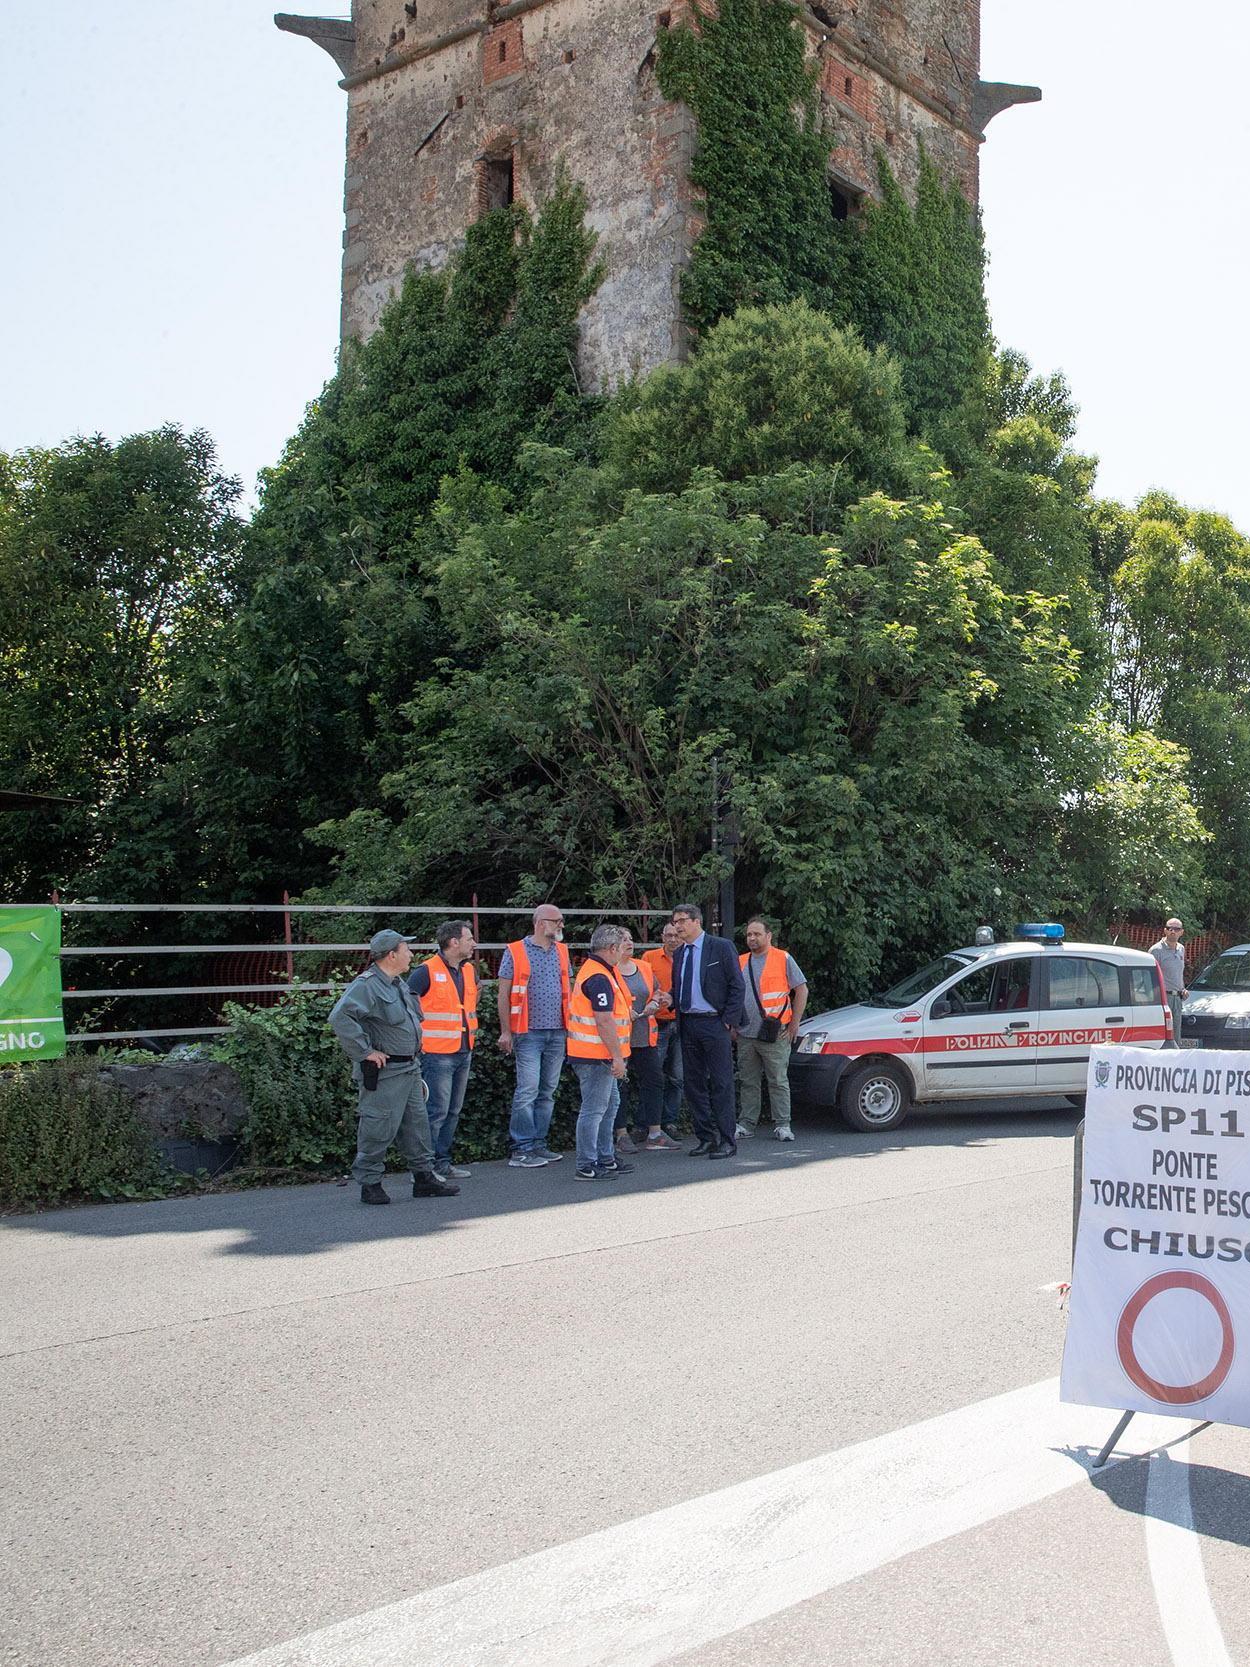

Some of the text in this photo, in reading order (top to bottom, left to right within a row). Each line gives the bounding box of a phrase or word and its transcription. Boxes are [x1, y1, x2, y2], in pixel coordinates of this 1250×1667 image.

[596, 992, 609, 1007] 3
[945, 1029, 1113, 1050] POLIZIA PROVINCIALE
[1115, 1064, 1198, 1095] PROVINCIA
[1202, 1069, 1222, 1095] DI
[1132, 1103, 1246, 1138] SP11
[1152, 1148, 1218, 1181] PONTE
[1089, 1178, 1197, 1215] TORRENTE
